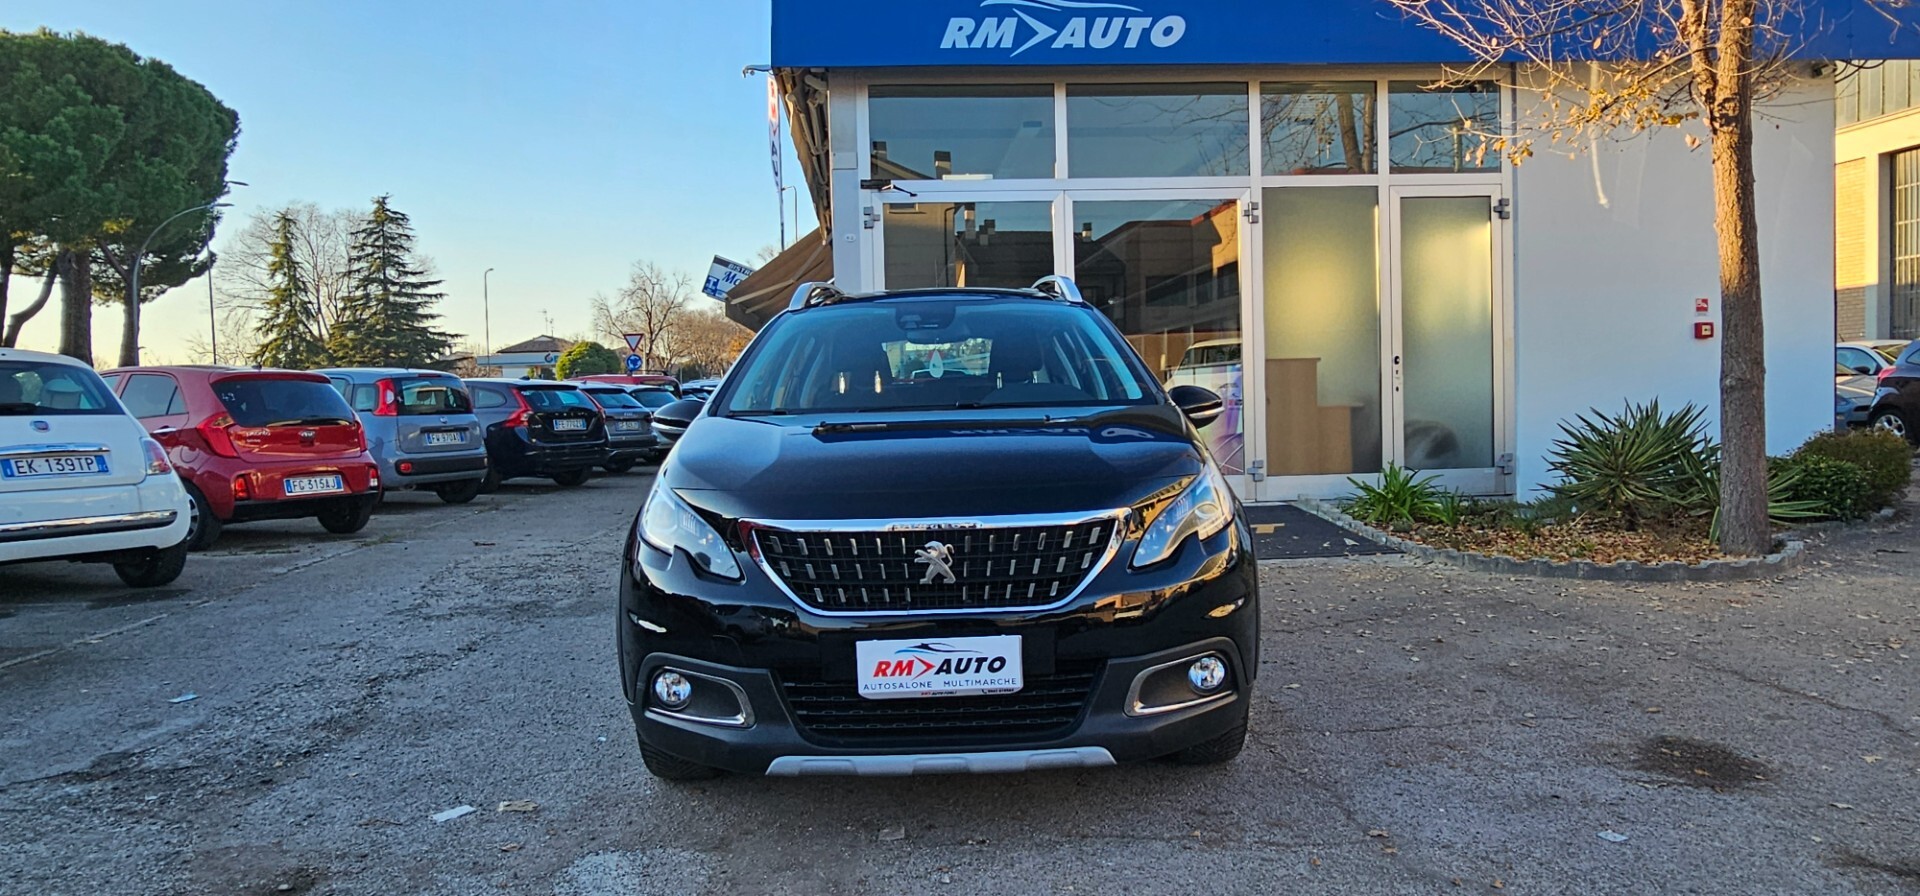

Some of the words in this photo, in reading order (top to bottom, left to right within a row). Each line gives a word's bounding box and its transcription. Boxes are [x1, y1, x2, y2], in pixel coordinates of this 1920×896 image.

[940, 17, 1018, 48] RM
[1050, 15, 1186, 48] AUTO
[14, 459, 38, 474] EK
[44, 457, 94, 472] 139TP
[873, 659, 914, 677] RM
[934, 656, 1007, 675] AUTO
[863, 681, 932, 690] AUTOSALONE
[943, 678, 1017, 687] MULTIMARCHE
